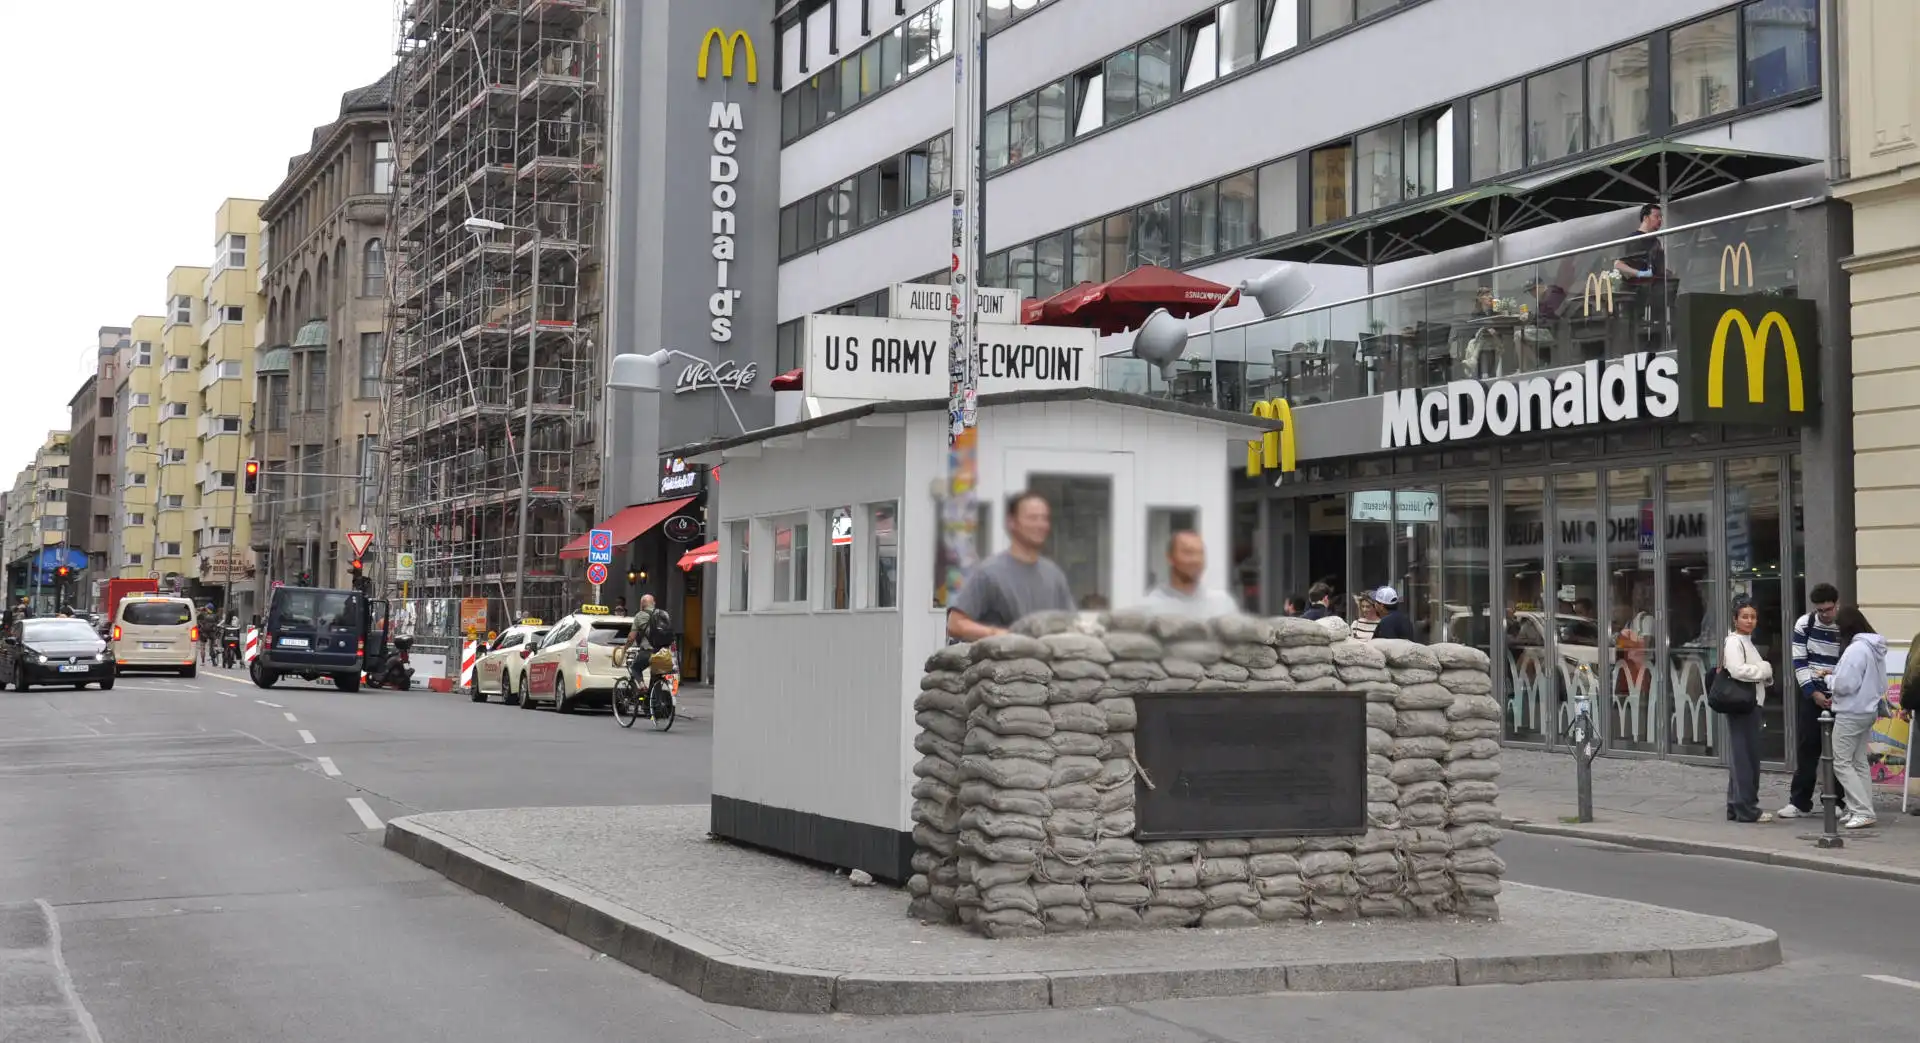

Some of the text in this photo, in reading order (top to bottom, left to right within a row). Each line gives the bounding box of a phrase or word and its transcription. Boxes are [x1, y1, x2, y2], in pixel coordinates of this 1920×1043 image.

[707, 100, 744, 343] McDonald's
[910, 290, 941, 311] ALLIED
[825, 335, 1084, 381] US ARMY ECKPOINT
[1380, 351, 1679, 449] McDonald's
[591, 551, 609, 561] TAXI
